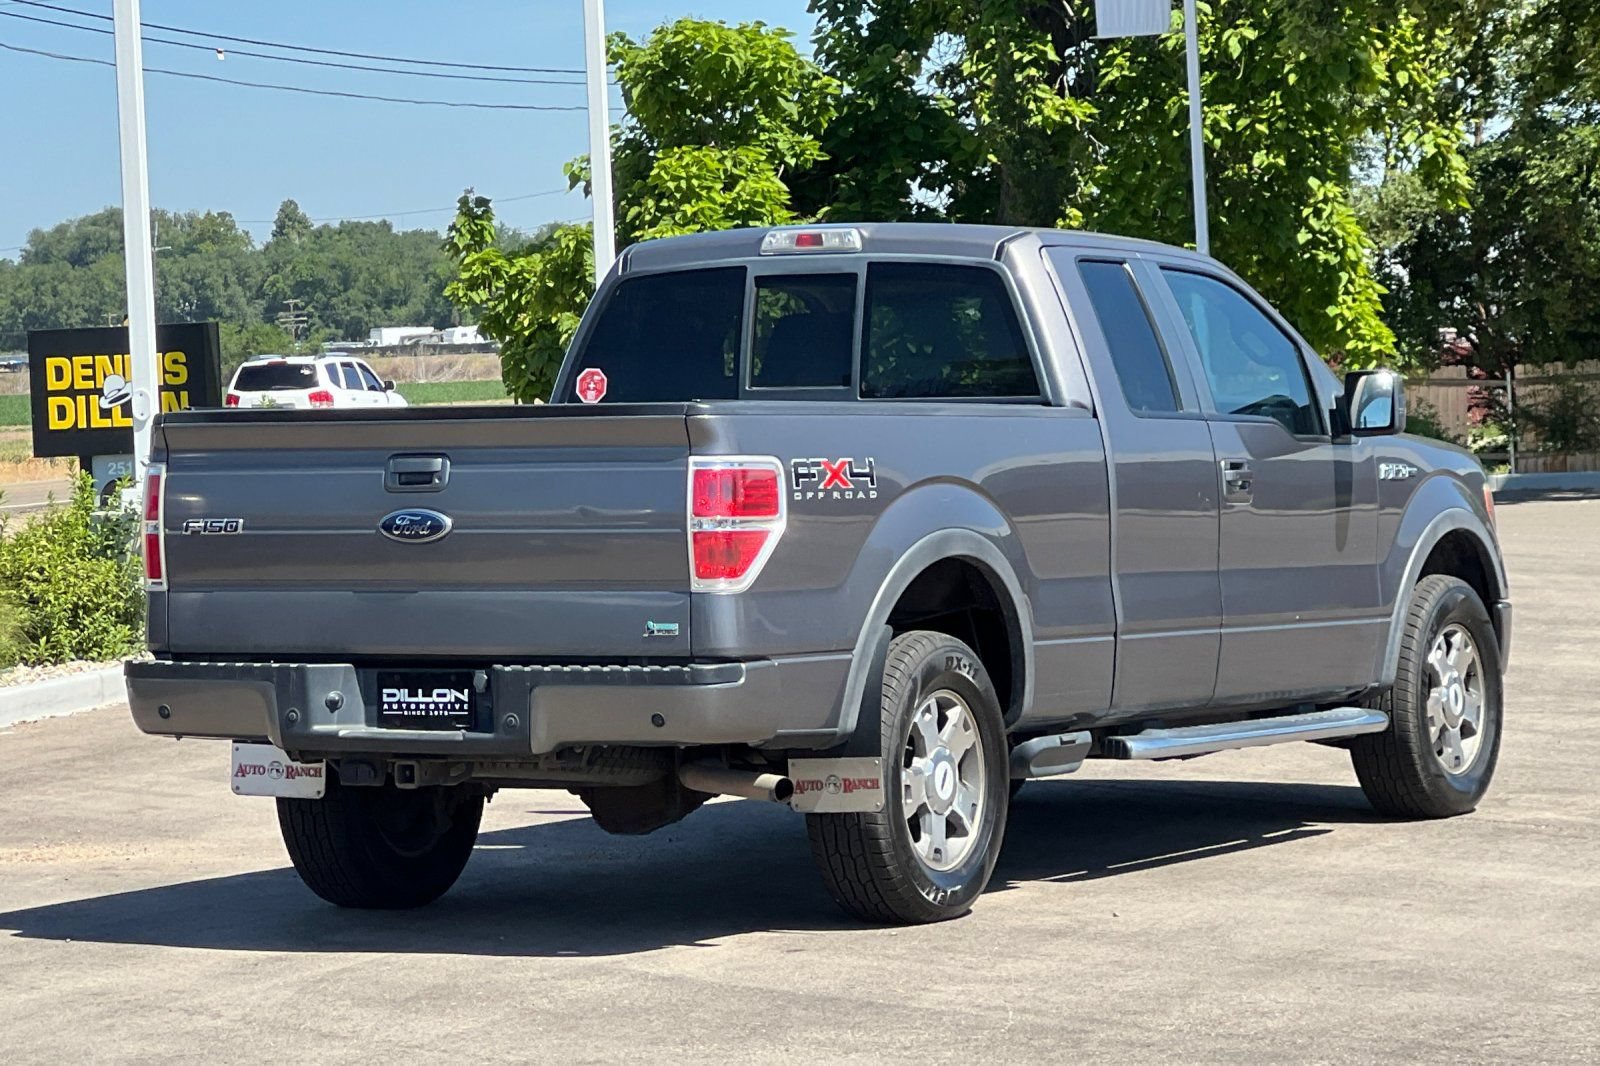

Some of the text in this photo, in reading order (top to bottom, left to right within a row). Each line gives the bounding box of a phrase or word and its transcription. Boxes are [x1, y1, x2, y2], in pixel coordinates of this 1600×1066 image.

[45, 351, 188, 391] DENIS
[47, 391, 190, 430] DILLN
[791, 458, 877, 489] FX4
[382, 688, 469, 702] DILLON
[233, 762, 323, 779] AUTO RANCH
[793, 777, 880, 794] AUTO RANCH
